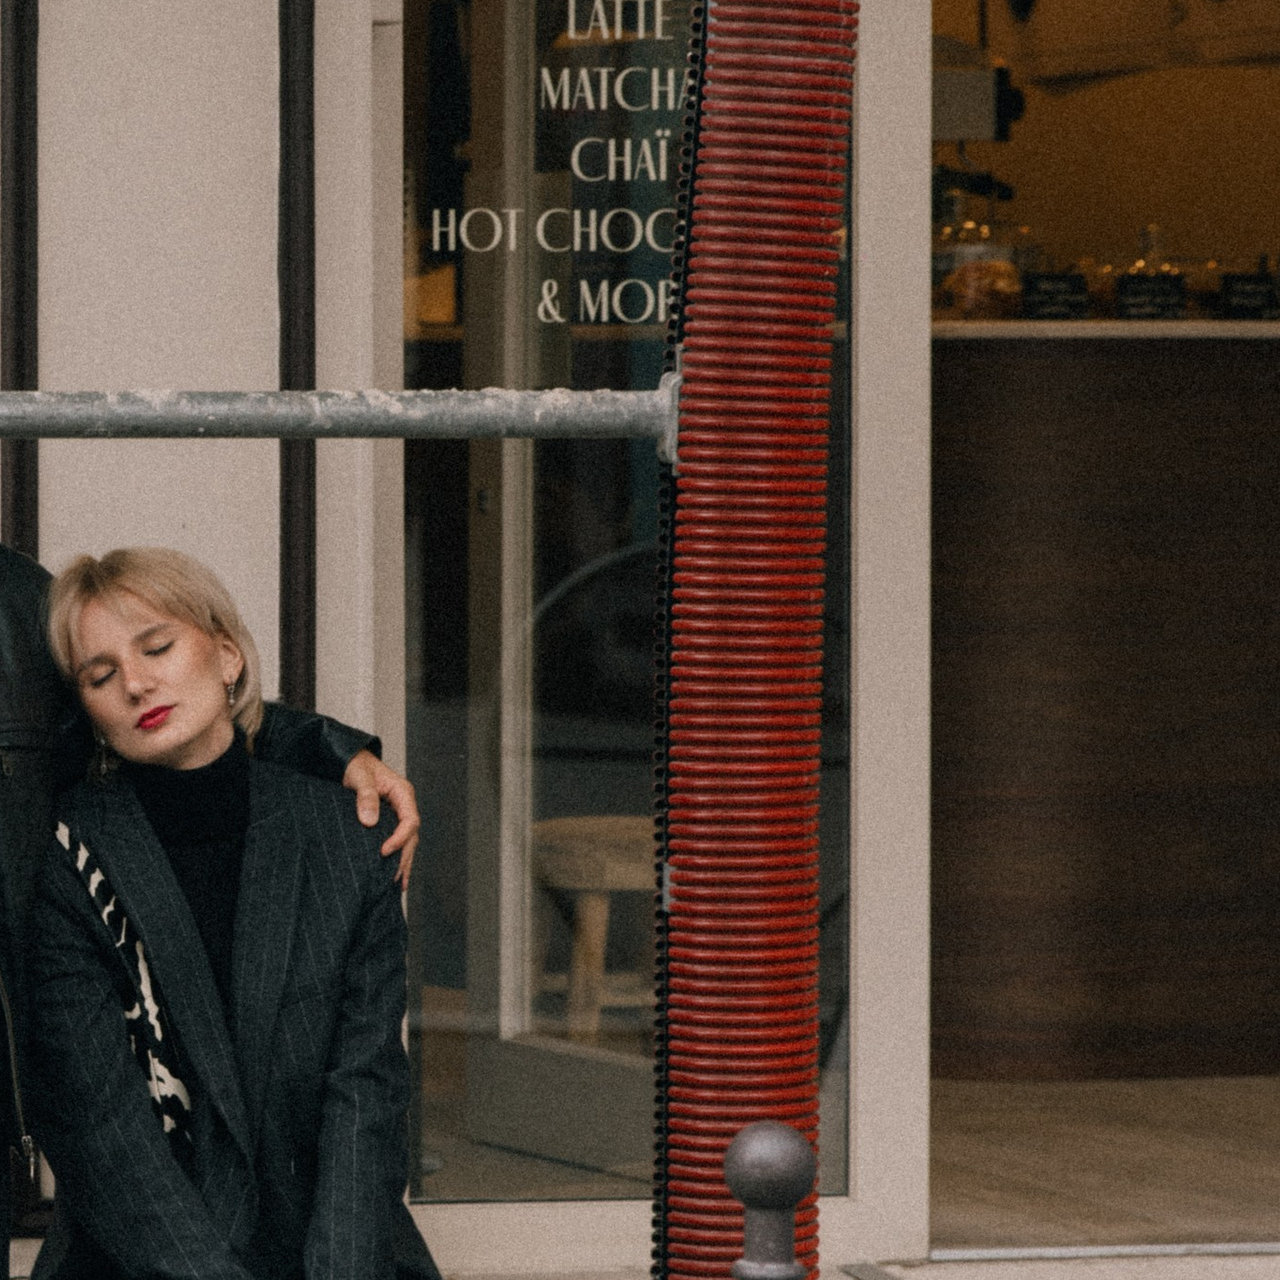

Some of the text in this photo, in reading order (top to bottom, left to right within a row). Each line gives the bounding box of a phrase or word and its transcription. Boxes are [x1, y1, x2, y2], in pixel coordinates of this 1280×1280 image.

[571, 129, 672, 182] CHAÏ
[432, 207, 524, 252] HOT
[537, 278, 567, 323] &
